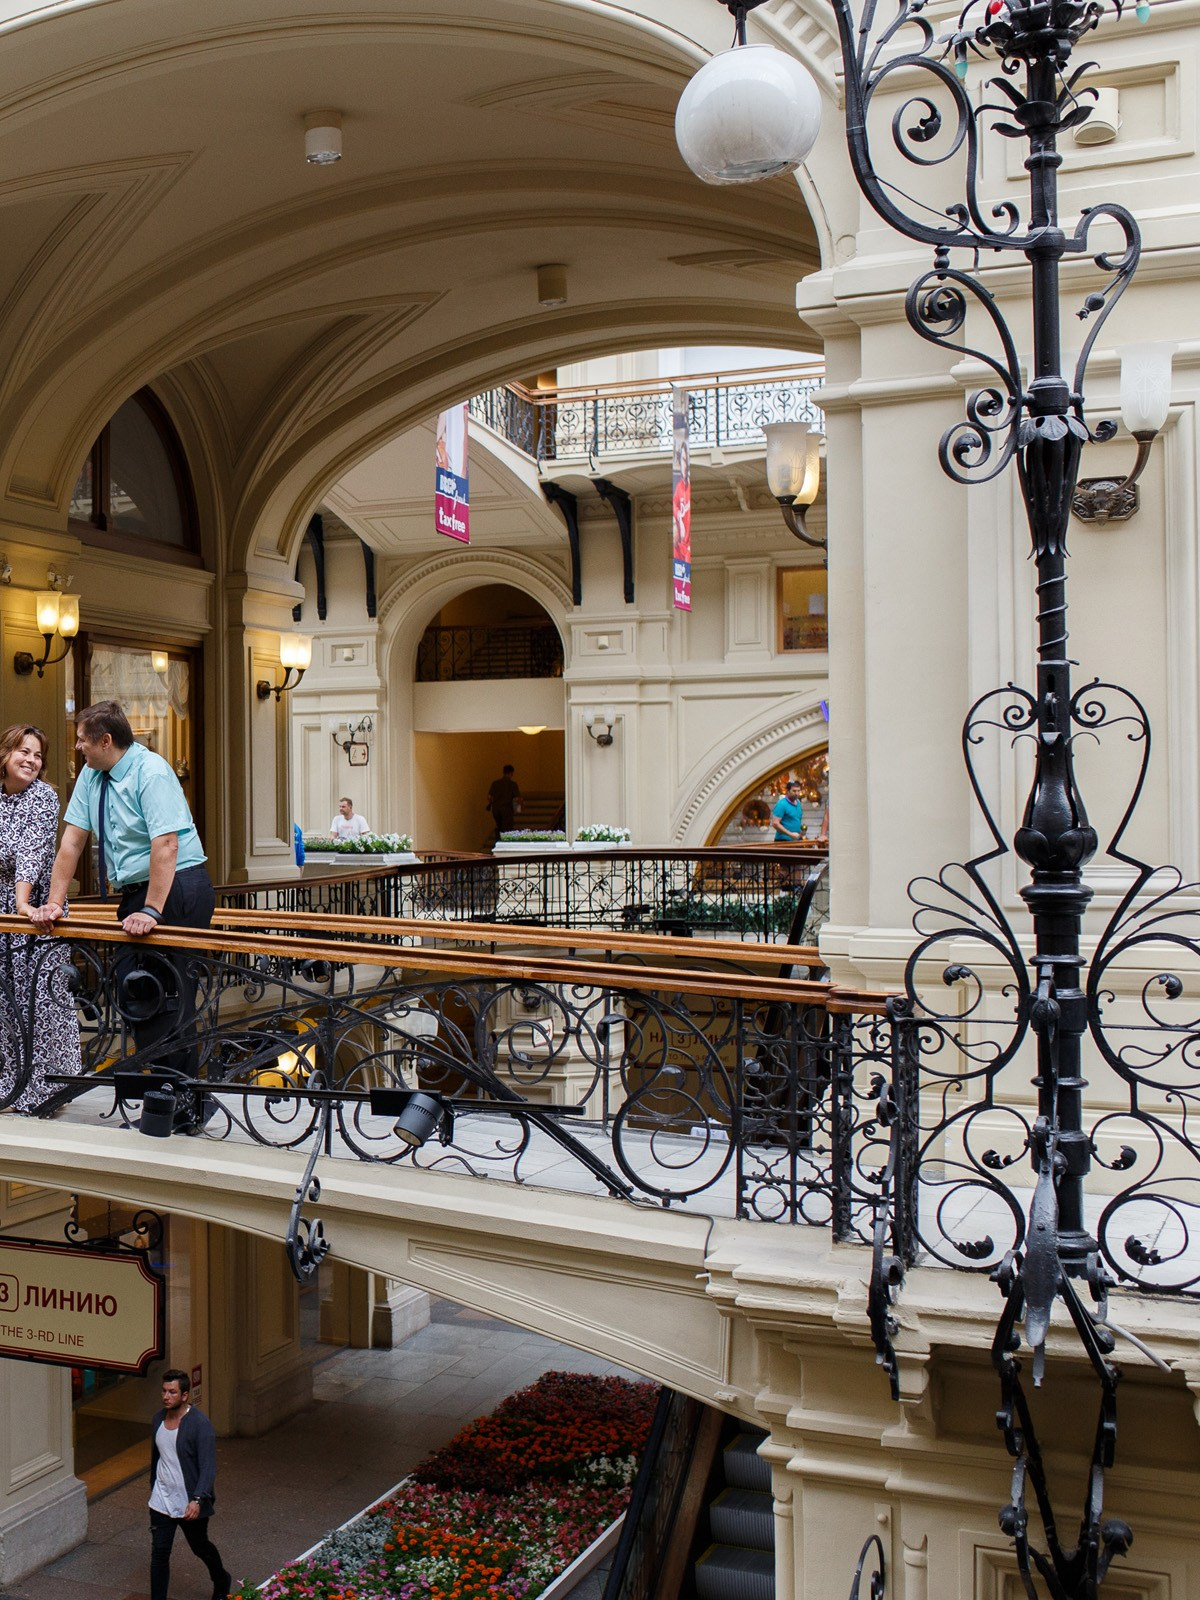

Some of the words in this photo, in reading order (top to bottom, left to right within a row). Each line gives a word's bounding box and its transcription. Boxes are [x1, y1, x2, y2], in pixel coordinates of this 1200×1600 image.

[24, 1285, 118, 1317] ЛИНИЮ
[0, 1324, 23, 1339] THE
[27, 1328, 55, 1343] 3-RD
[58, 1332, 84, 1347] LINE
